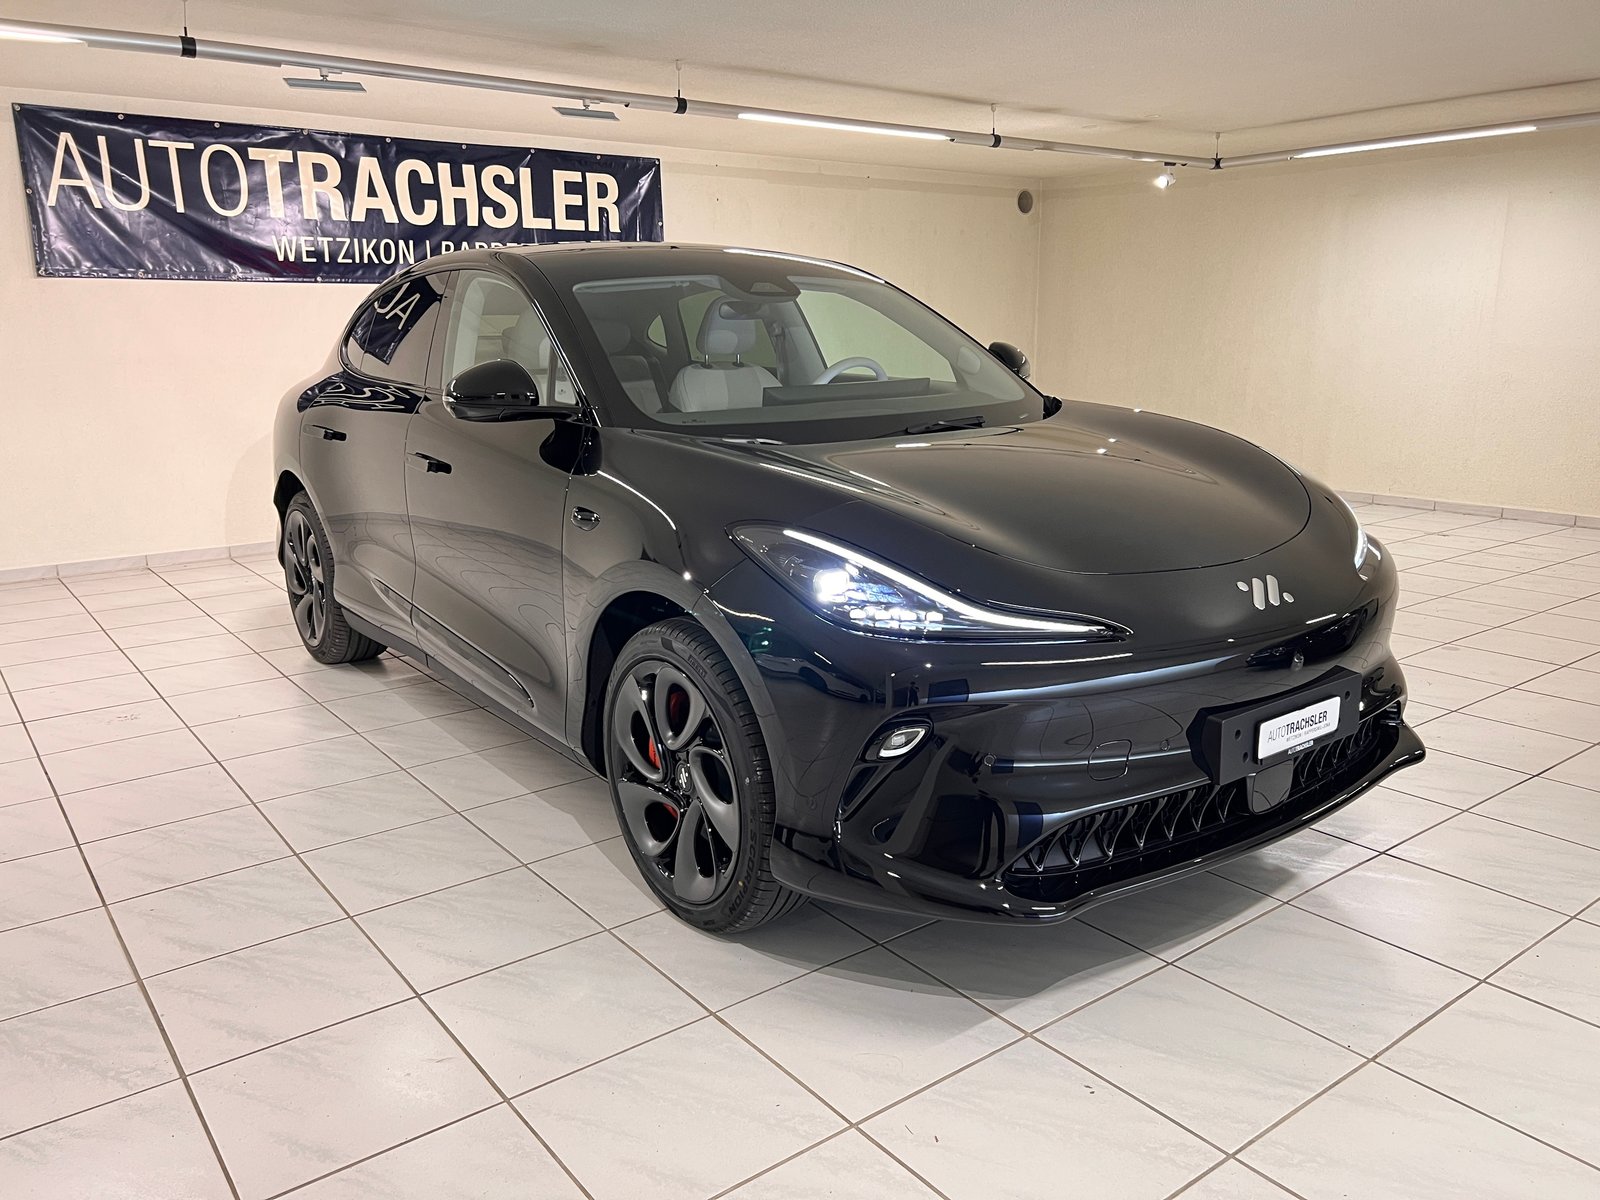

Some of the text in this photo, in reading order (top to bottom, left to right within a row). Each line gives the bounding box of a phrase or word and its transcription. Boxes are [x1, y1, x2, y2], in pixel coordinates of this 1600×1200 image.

[47, 131, 621, 233] AUTOTRACHSLER
[271, 235, 415, 265] WETZIKON
[1267, 710, 1328, 743] AUTOTRACHSLER
